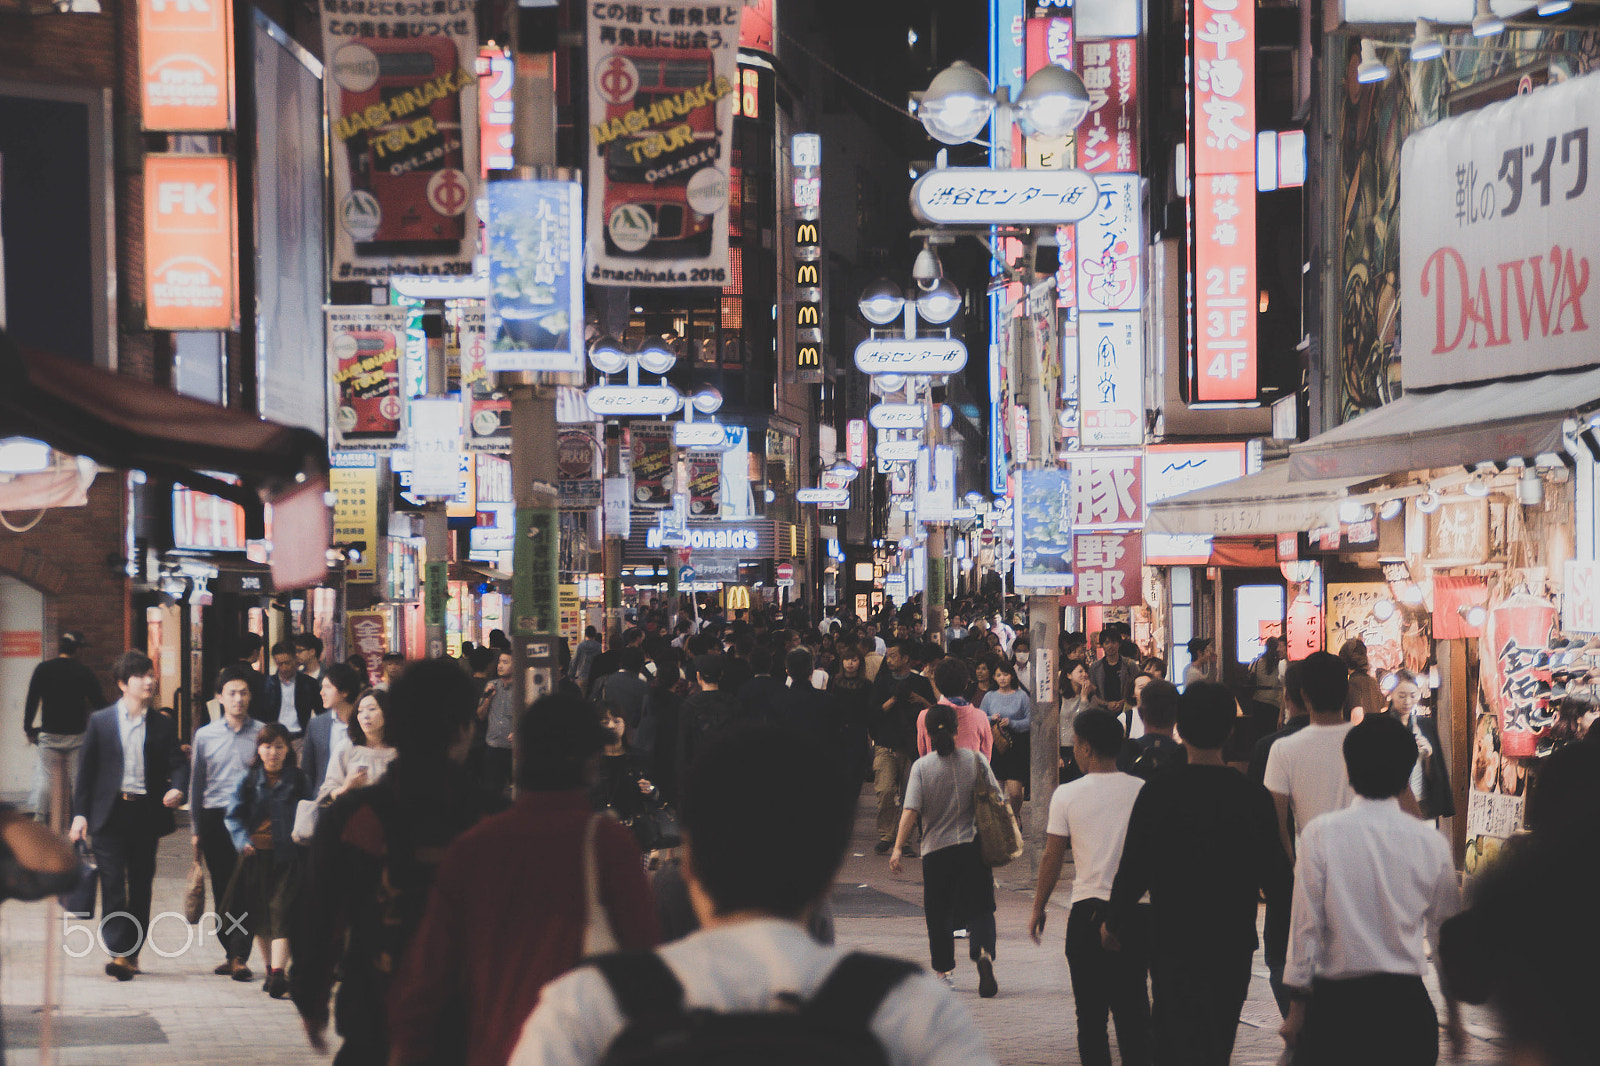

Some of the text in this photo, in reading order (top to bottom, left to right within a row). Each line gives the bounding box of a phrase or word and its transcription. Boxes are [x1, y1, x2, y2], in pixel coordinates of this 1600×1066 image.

[335, 69, 475, 140] MACHINAKA
[593, 76, 733, 145] MACHINAKA
[1083, 43, 1111, 170] 野郎ラーメン
[368, 117, 437, 157] TOUR
[626, 124, 694, 163] TOUR
[928, 187, 1087, 206] 渋谷センター街
[1455, 127, 1588, 228] 靴のダイワ
[158, 183, 218, 214] FK
[1206, 268, 1248, 295] 2F
[1420, 244, 1590, 355] DAIWA
[1207, 310, 1248, 337] 3F
[862, 350, 960, 362] 渋谷センター街
[1207, 352, 1248, 379] 4F
[1071, 457, 1137, 524] 豚
[647, 529, 758, 548] MDonald's
[1076, 536, 1126, 604] 野郎
